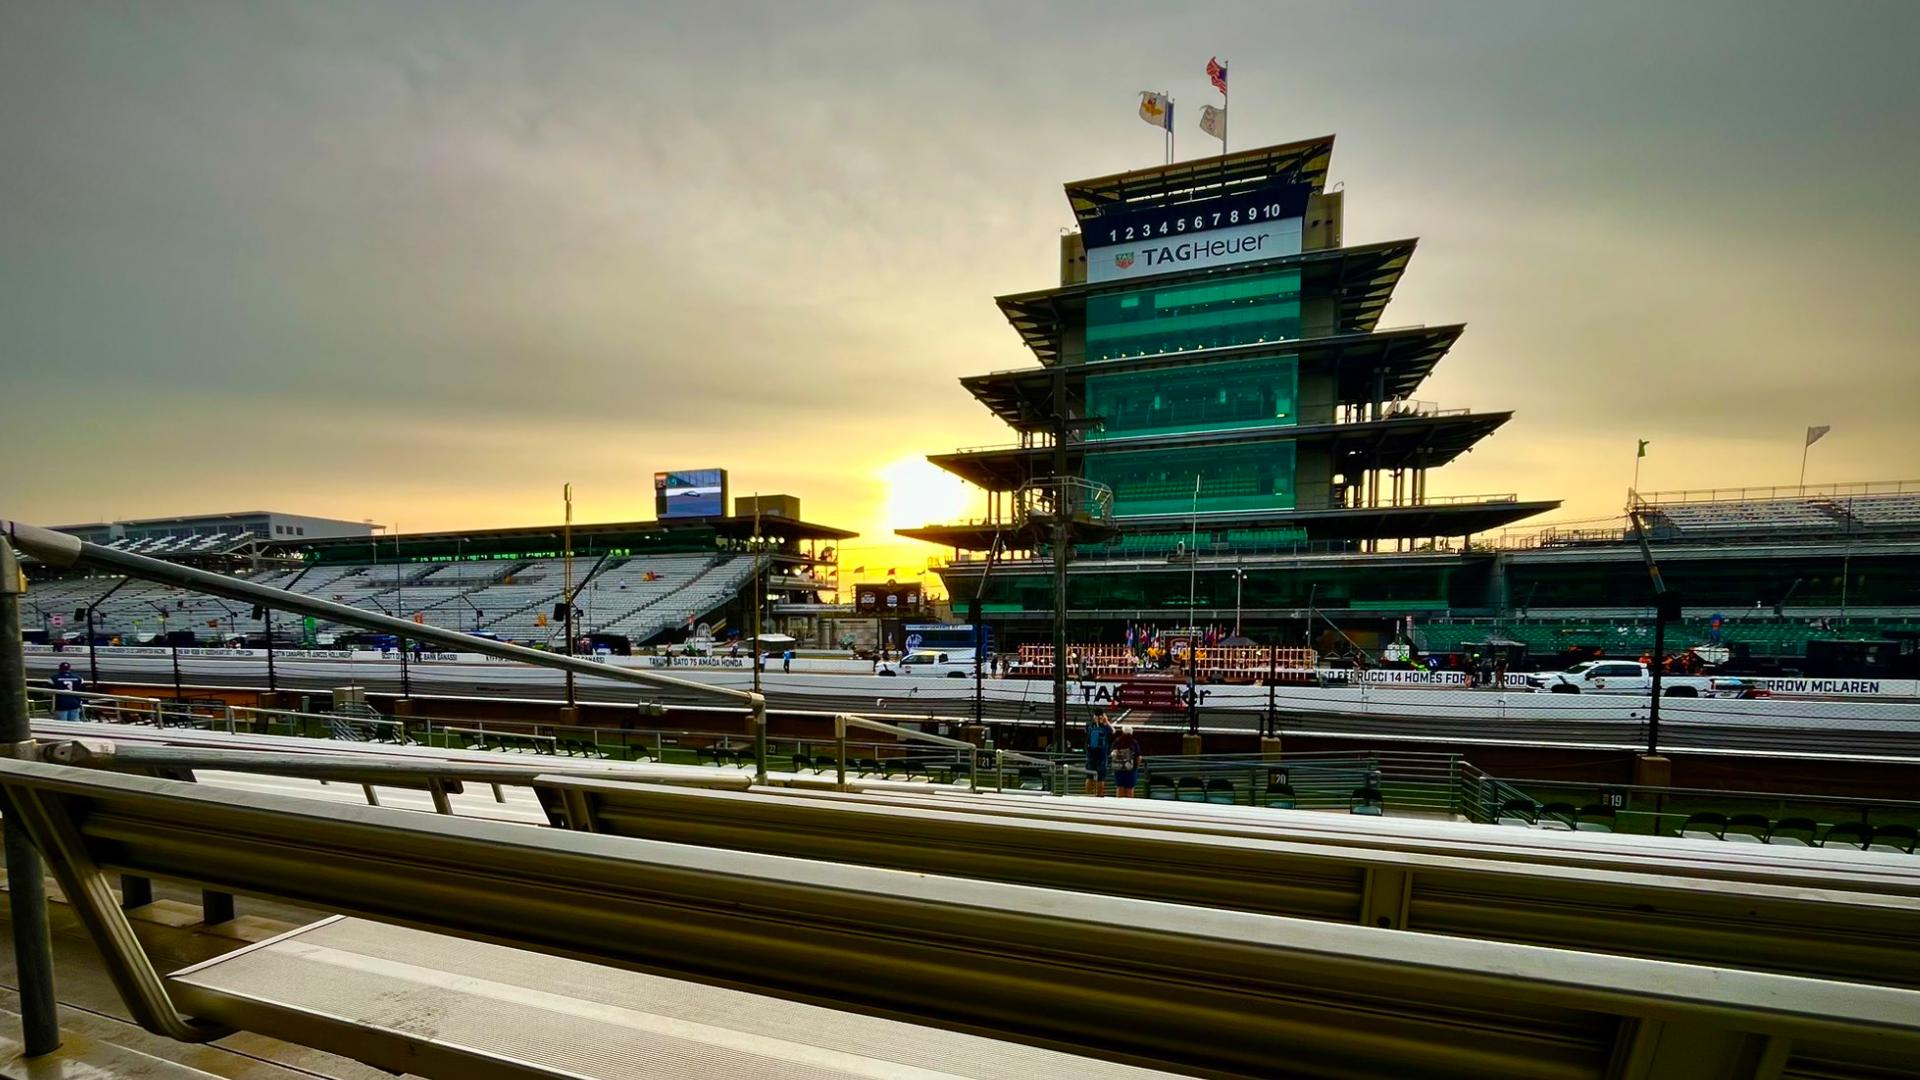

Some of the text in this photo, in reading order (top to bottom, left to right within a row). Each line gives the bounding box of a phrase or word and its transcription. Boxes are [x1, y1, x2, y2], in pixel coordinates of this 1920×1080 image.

[1110, 203, 1281, 242] 1 2 3 4 5 6 7 8 9 10
[673, 657, 688, 666] SATO
[690, 658, 697, 666] 75
[698, 658, 719, 667] AMADA
[721, 658, 743, 668] HONDA
[1391, 672, 1401, 682] 14
[1404, 672, 1442, 684] HOMES
[1445, 673, 1466, 685] FOR
[1767, 679, 1879, 694] RROW MCLAREN
[981, 756, 990, 768] 21
[1275, 773, 1287, 785] 20
[1610, 794, 1623, 807] 19
